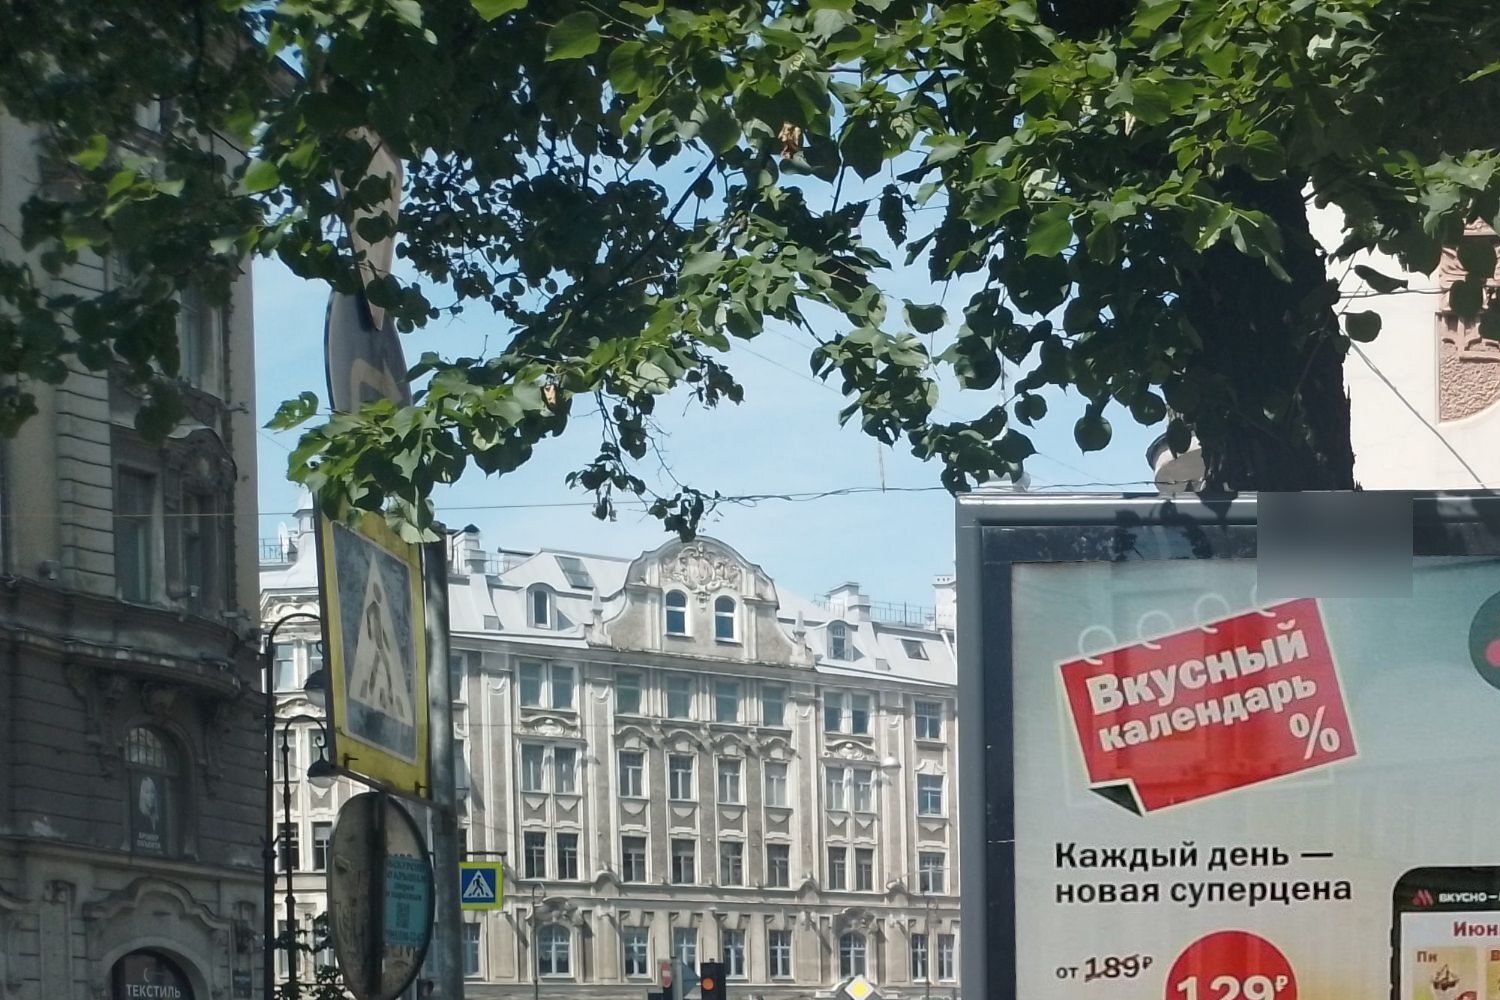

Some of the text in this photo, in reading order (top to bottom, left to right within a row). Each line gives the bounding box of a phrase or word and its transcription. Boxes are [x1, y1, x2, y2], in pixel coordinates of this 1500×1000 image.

[1085, 619, 1309, 715] Вкусный
[1099, 675, 1317, 751] календарь
[1288, 705, 1341, 760] %
[1055, 841, 1198, 872] Каждый
[1208, 846, 1290, 872] день
[1055, 879, 1353, 908] новая суперцена
[1438, 891, 1487, 903] ВКУСНО
[1416, 951, 1438, 963] Пн
[1056, 966, 1079, 979] от
[126, 984, 182, 999] ТЕКСТИЛЬ
